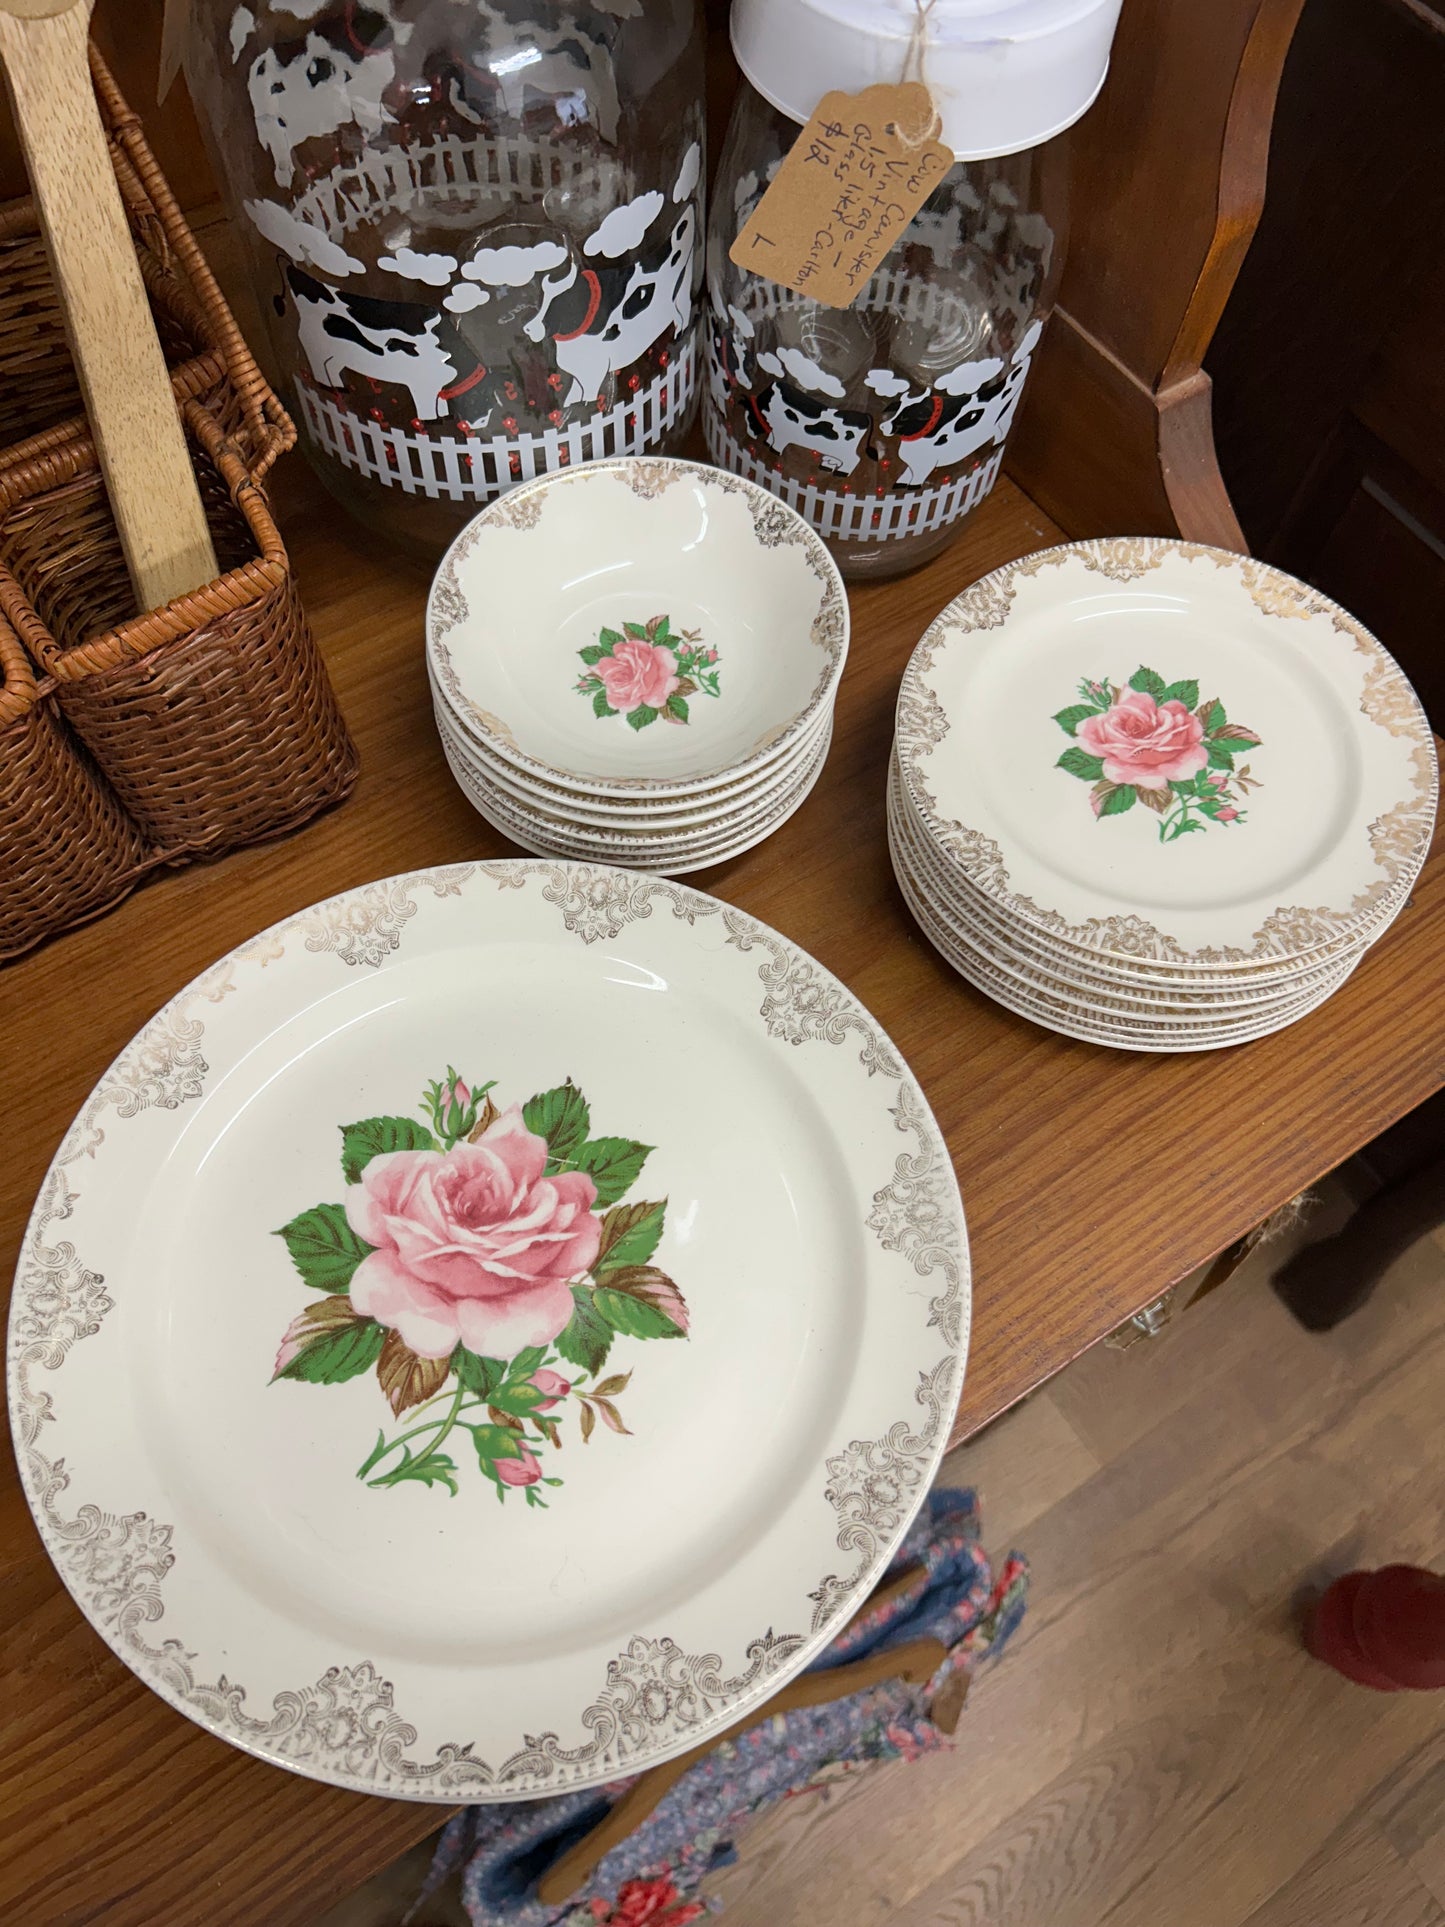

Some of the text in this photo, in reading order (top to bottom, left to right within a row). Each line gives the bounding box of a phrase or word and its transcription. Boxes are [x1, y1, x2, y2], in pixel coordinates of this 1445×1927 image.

[804, 120, 850, 166] $12
[833, 123, 872, 183] Glass
[859, 147, 887, 178] 1.5
[832, 184, 863, 222] liter
[844, 160, 908, 243] Vintage
[845, 153, 945, 287] Cow Canister
